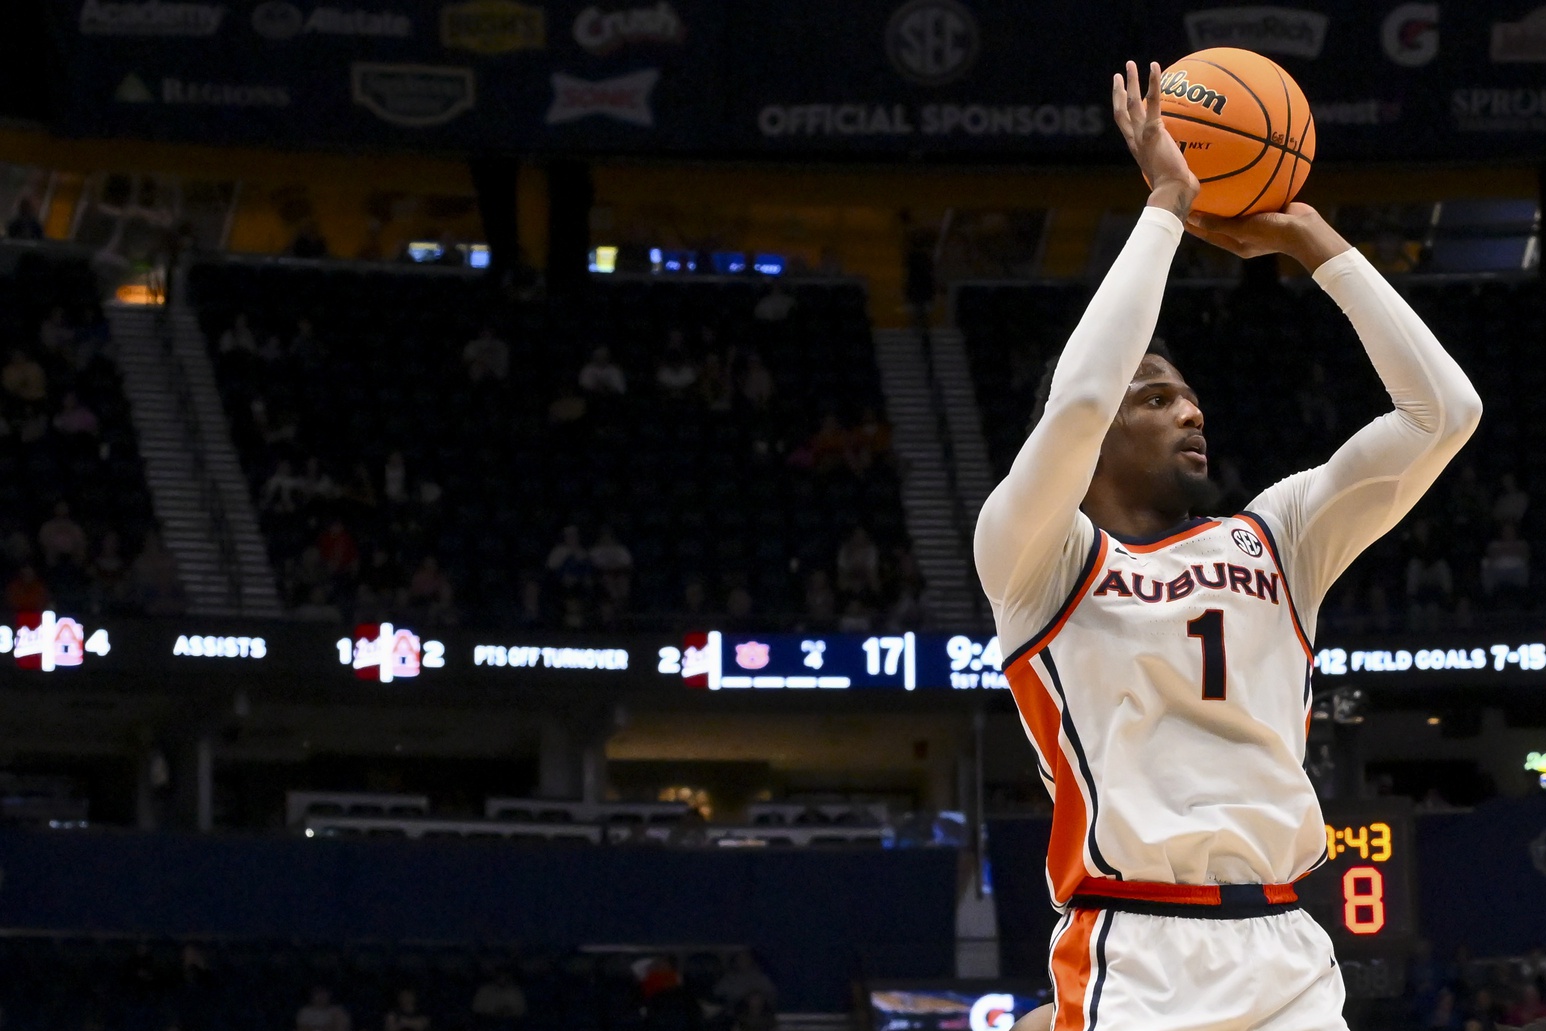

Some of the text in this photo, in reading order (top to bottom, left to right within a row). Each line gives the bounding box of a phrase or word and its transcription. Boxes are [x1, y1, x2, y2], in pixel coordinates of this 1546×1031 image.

[1380, 3, 1440, 68] G
[1160, 70, 1227, 115] ilson
[757, 105, 1106, 137] OFFICIAL SPONSORS
[1233, 530, 1262, 557] SEC
[1093, 562, 1280, 605] AUBURN
[85, 629, 111, 657] 4
[173, 635, 268, 659] ASSISTS
[337, 637, 353, 665] 1
[423, 640, 446, 668] 2
[474, 645, 507, 666] PTS
[508, 646, 540, 667] OFF
[862, 636, 905, 675] 17
[947, 635, 1003, 671] 9:4
[1187, 609, 1227, 701] 1
[1351, 650, 1412, 672] FIELD
[1415, 648, 1487, 671] GOALS
[1490, 643, 1546, 672] 7-15
[658, 646, 681, 674] 2
[982, 671, 1010, 689] HA
[1341, 865, 1385, 934] 8
